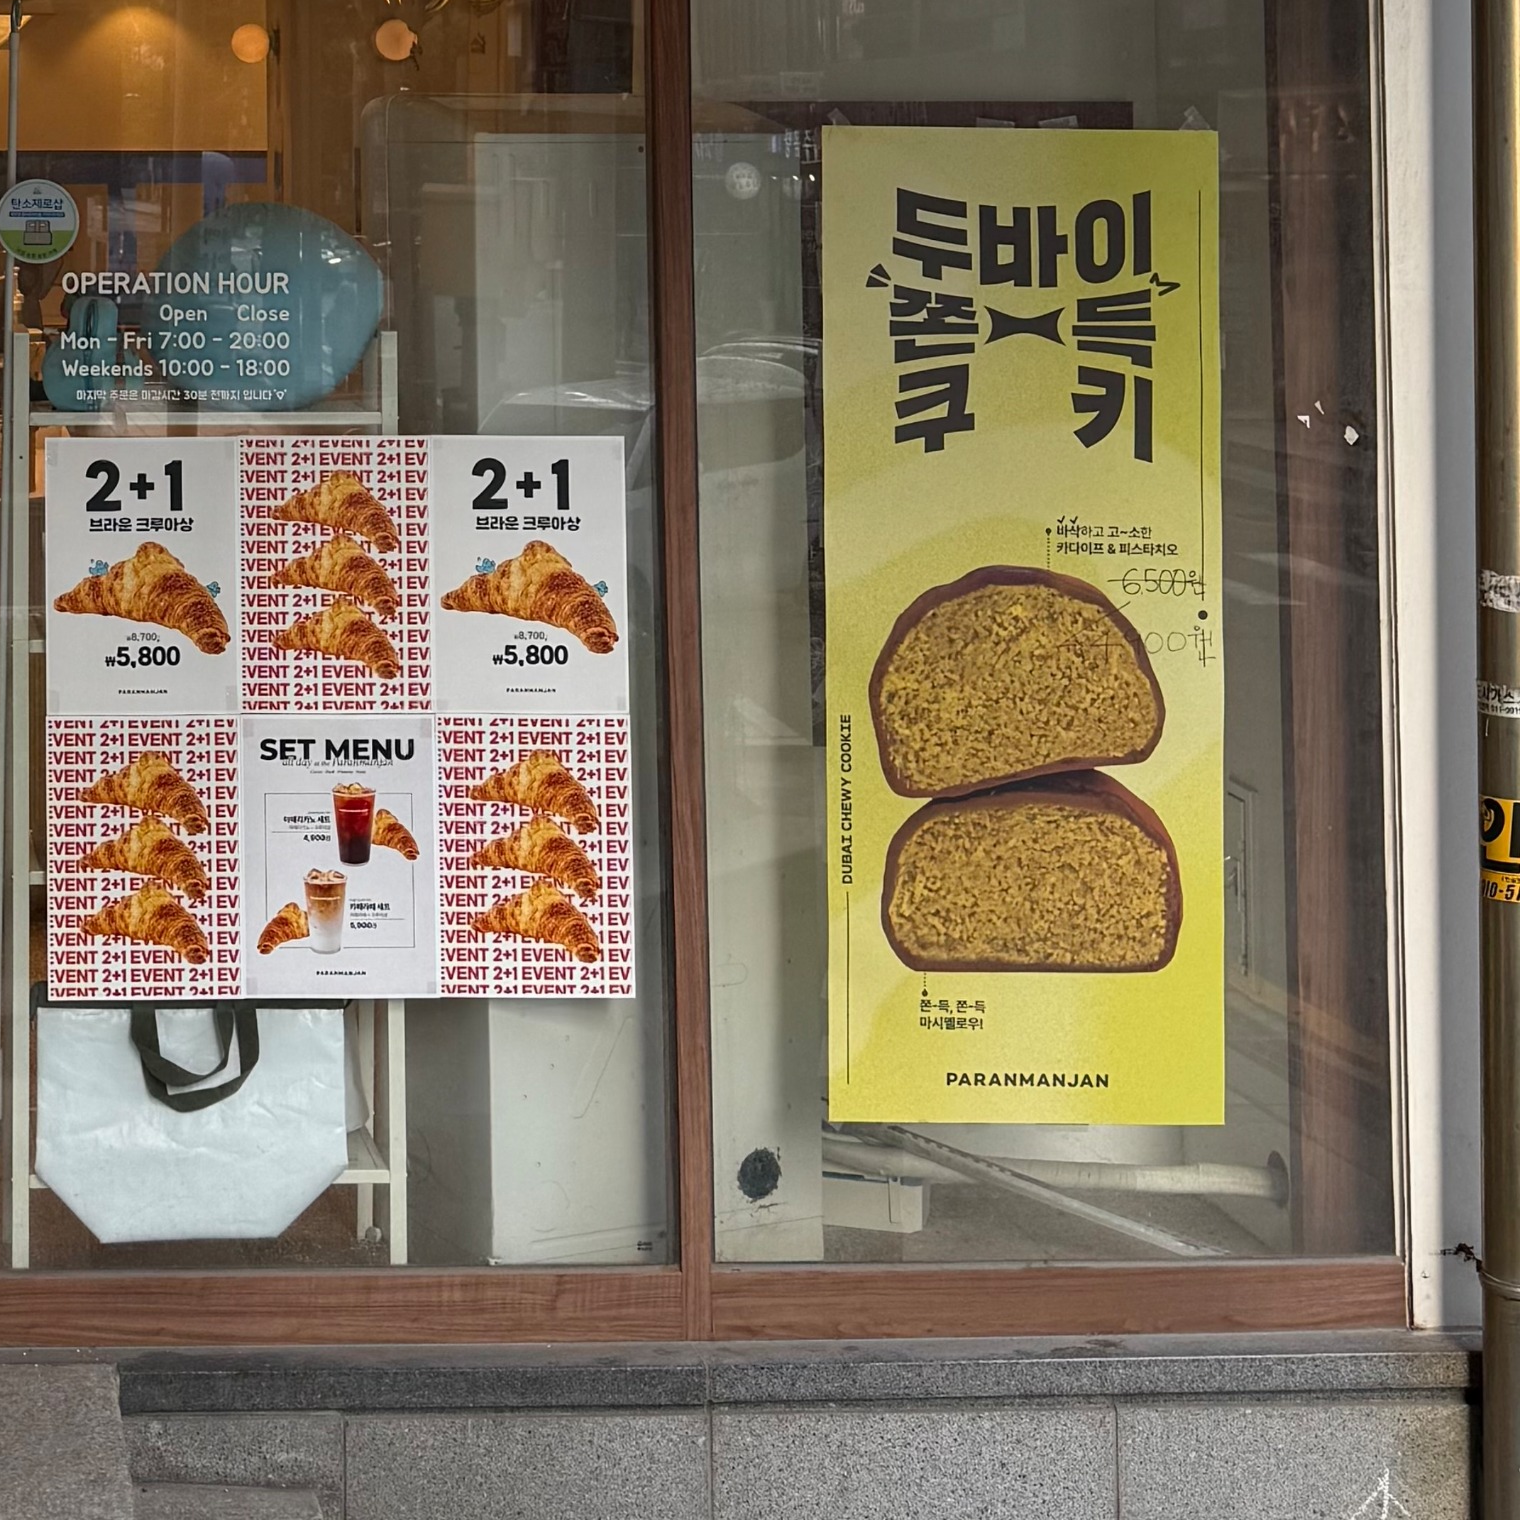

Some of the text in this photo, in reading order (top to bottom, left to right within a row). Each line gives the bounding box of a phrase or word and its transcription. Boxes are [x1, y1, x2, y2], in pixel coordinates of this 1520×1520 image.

[11, 198, 64, 211] 탄소제로샵
[892, 187, 1151, 288] 두바이
[61, 271, 290, 296] OPERATION HOUR
[159, 303, 290, 327] Open Close
[61, 332, 102, 351] Mon
[123, 331, 153, 350] Fri
[158, 331, 206, 350] 7:00
[229, 331, 290, 350] 20:00
[61, 359, 154, 378] Weekends
[158, 358, 214, 378] 10:00
[236, 358, 290, 377] 18:00
[76, 389, 272, 401] 마지막 주문은 마감시간 30분 전까지 입니다
[291, 453, 315, 466] 2+1
[320, 453, 373, 466] EVENT
[377, 453, 401, 466] 2+1
[292, 470, 315, 483] 2+1
[377, 470, 401, 483] 2+1
[85, 459, 184, 512] 2+1
[471, 457, 570, 511] 2+1
[89, 516, 194, 533] 브라운 크루아상
[292, 524, 316, 537] 2+1
[475, 515, 581, 532] 브라운 크루아상
[1056, 524, 1104, 538] 바삭하고
[1107, 542, 1117, 555] &
[1119, 542, 1179, 556] 피스타치오
[105, 645, 181, 668] ₩5,800
[492, 644, 569, 667] ₩5,800
[294, 666, 318, 679] 2+1
[294, 683, 318, 696] 2+1
[322, 683, 376, 696] EVENT
[380, 683, 404, 696] 2+1
[100, 733, 124, 747] 2+1
[128, 733, 181, 747] EVENT
[186, 733, 210, 747] 2+1
[490, 731, 514, 745] 2+1
[518, 731, 572, 745] EVENT
[577, 731, 601, 745] 2+1
[259, 738, 415, 761] SET MENU
[490, 749, 514, 763] 2+1
[577, 749, 601, 763] 2+1
[100, 751, 124, 765] 2+1
[186, 751, 211, 765] 2+1
[840, 714, 853, 885] DUBAI CHEWY COOKIE
[100, 806, 125, 819] 2+1
[491, 804, 515, 817] 2+1
[102, 951, 126, 964] 2+1
[493, 949, 517, 962] 2+1
[102, 969, 127, 982] 2+1
[131, 969, 185, 982] EVENT
[189, 969, 213, 982] 2+1
[493, 967, 518, 980] 2+1
[522, 967, 576, 980] EVENT
[580, 967, 605, 980] 2+1
[945, 1072, 1110, 1089] PARANMANJAN
